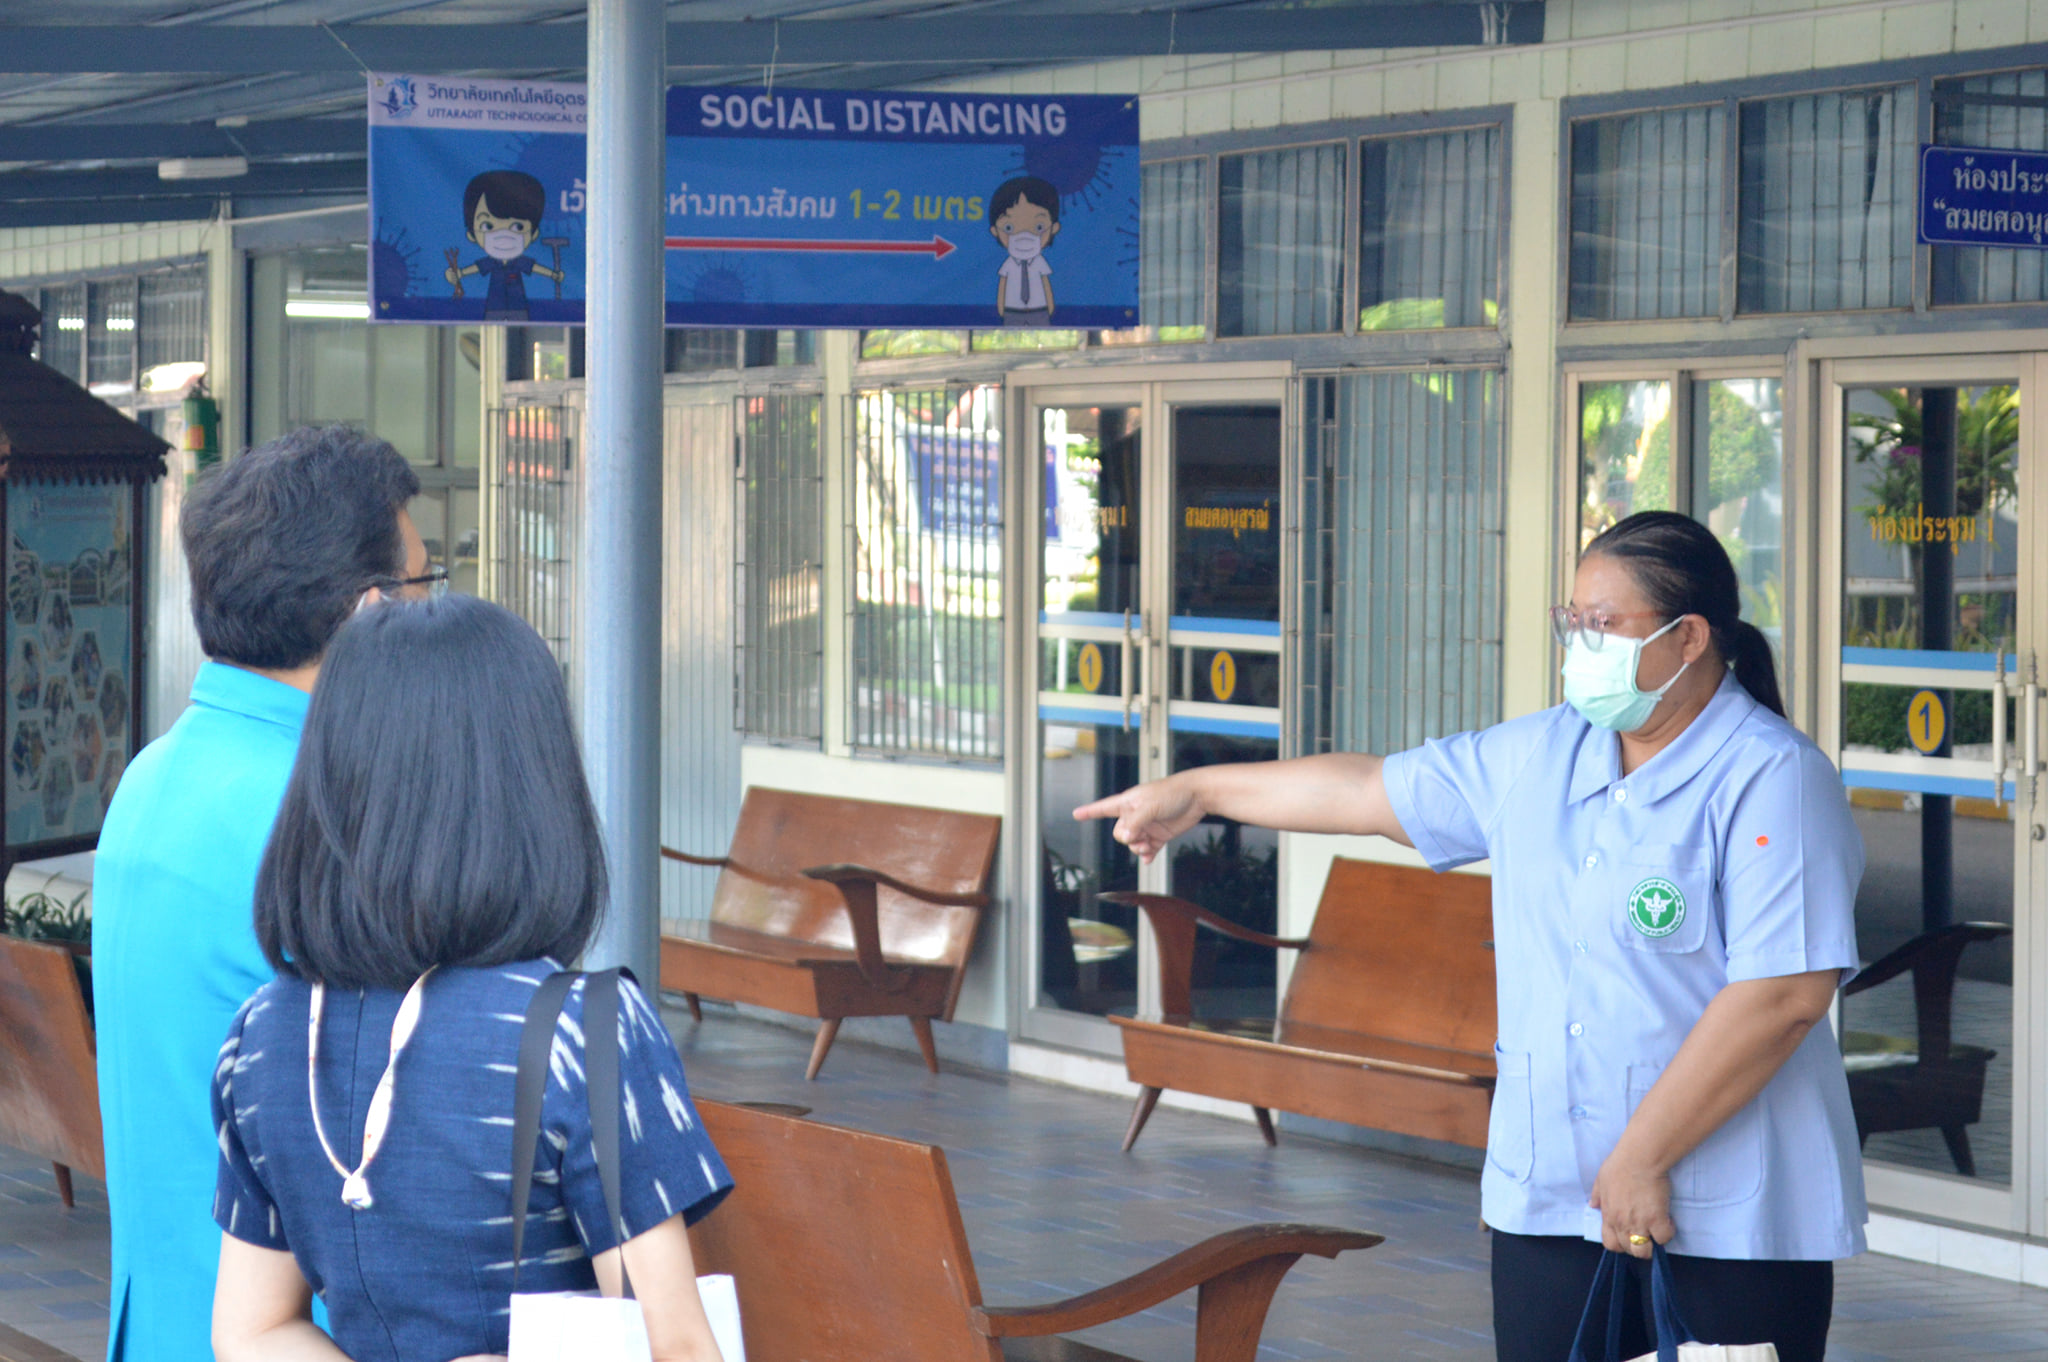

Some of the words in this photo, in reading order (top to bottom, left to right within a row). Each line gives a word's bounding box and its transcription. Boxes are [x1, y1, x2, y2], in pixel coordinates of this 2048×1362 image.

[427, 82, 587, 110] วิทยาลัยเทคโนโลยีอุตร
[427, 107, 483, 120] UTTARADIT
[487, 110, 572, 123] TECHNOLOGICAL
[700, 94, 836, 130] SOCIAL
[846, 98, 1067, 136] DISTANCING
[1953, 156, 2048, 194] ห้องประ
[850, 188, 901, 220] 1-2
[914, 195, 984, 221] เมตร
[1869, 501, 1977, 556] ห้องประชุม
[1218, 659, 1226, 691] 1
[1919, 701, 1930, 741] 1
